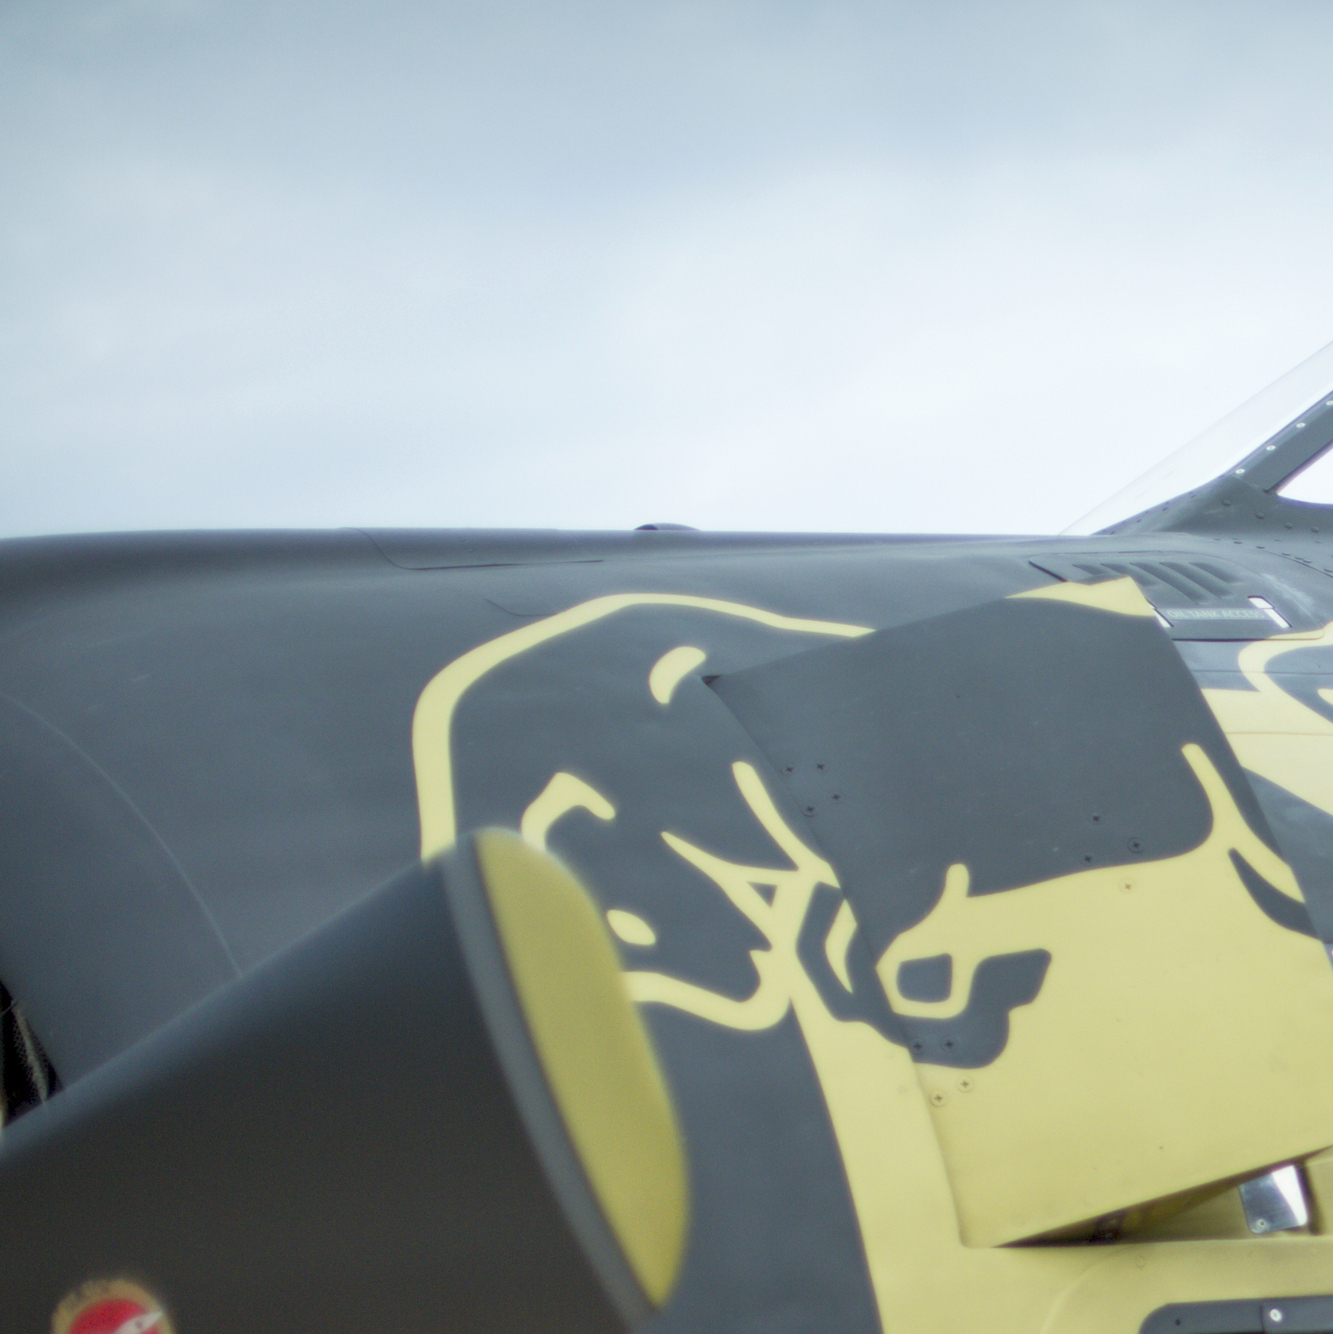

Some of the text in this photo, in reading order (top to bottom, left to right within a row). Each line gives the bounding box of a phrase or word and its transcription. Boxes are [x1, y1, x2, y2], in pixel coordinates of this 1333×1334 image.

[1166, 609, 1265, 619] OIL TANK ACCESS
